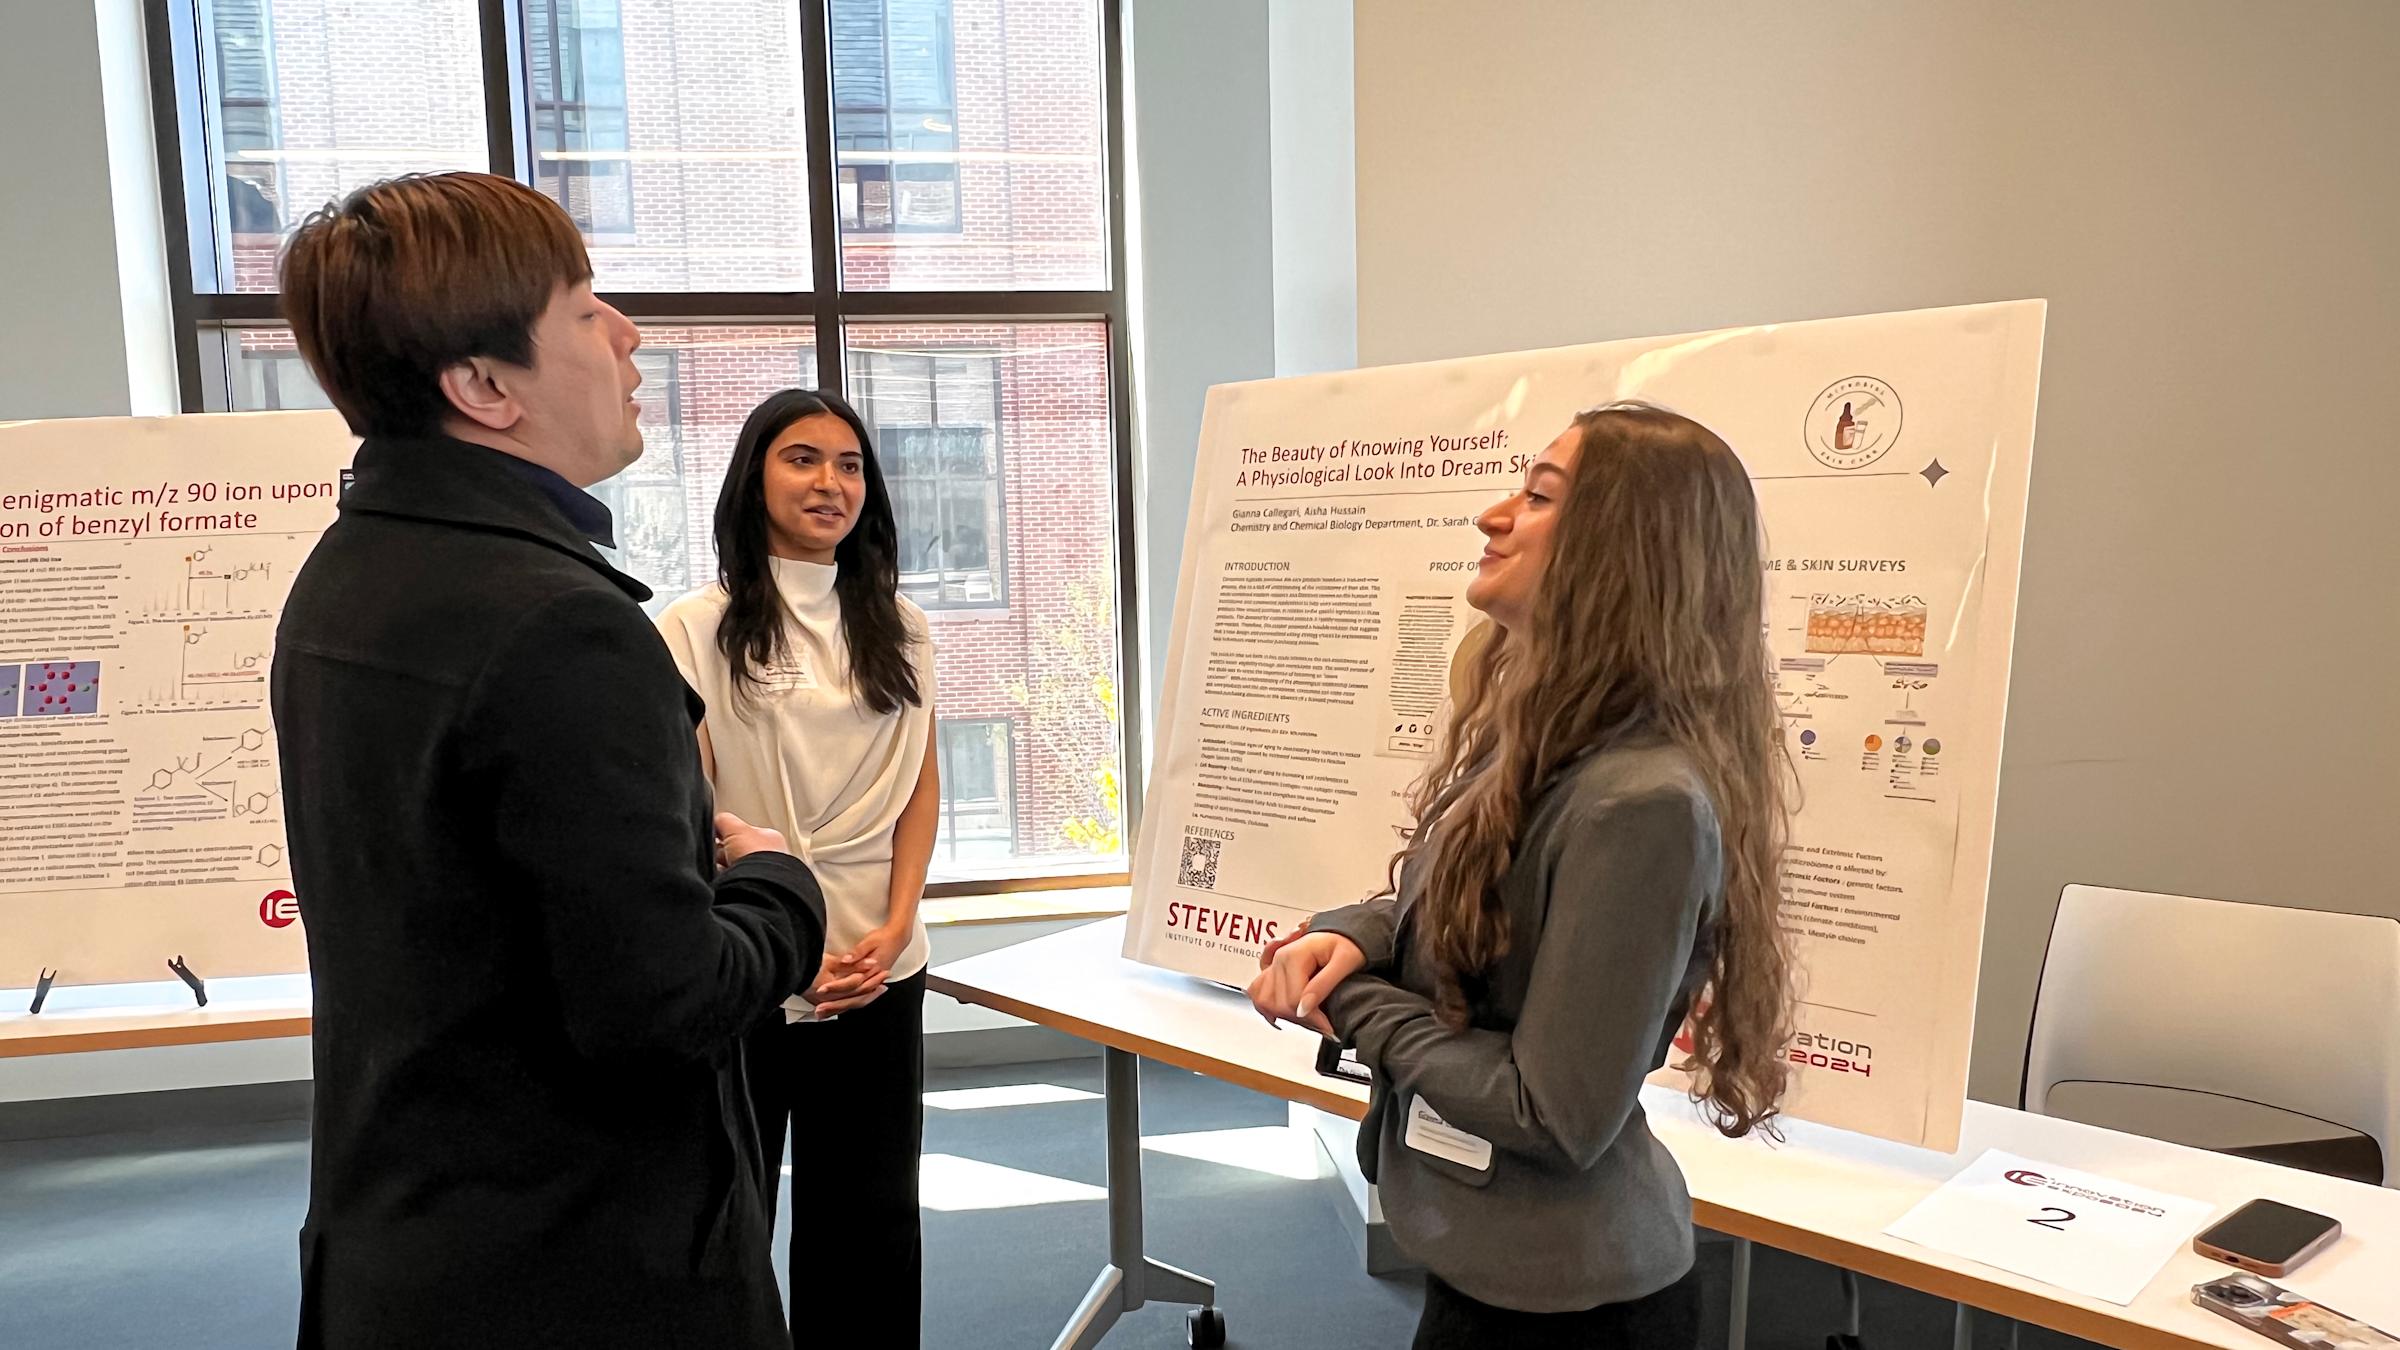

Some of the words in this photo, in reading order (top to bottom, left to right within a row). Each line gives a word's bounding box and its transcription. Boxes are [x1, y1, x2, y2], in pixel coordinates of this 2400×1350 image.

[1241, 448, 1267, 464] The
[1272, 445, 1325, 463] Beauty
[1329, 440, 1348, 458] of
[1351, 437, 1424, 458] Knowing
[1430, 430, 1509, 452] Yourself:
[1236, 471, 1247, 487] A
[1252, 463, 1350, 489] Physiological
[1355, 462, 1395, 481] Look
[1400, 462, 1436, 479] Into
[1441, 459, 1503, 477] Dream
[3, 489, 124, 513] enigmatic
[132, 481, 179, 508] m/z
[187, 482, 217, 503] 90
[226, 482, 262, 501] ion
[272, 482, 333, 503] upon
[1232, 509, 1261, 519] Gianna
[1304, 506, 1328, 516] Aisha
[1330, 506, 1366, 516] Hussain
[39, 515, 66, 537] of
[72, 512, 151, 538] benzyl
[160, 511, 257, 532] formate
[1231, 523, 1271, 533] Chemistry
[1273, 522, 1288, 531] and
[1289, 520, 1328, 531] Chemical
[1330, 520, 1362, 531] Biology
[1365, 519, 1423, 530] Department,
[1426, 517, 1439, 527] Dr.
[1442, 516, 1469, 527] Sarah
[1224, 562, 1291, 571] INTRODUCTION
[1429, 561, 1465, 571] PROOF
[1786, 559, 1797, 571] &
[1801, 559, 1834, 571] SKIN
[1838, 559, 1906, 571] SURVEYS
[1201, 707, 1229, 719] ACTIVE
[1232, 710, 1290, 723] INGREDIENTS
[1184, 824, 1235, 841] REFERENCES
[1167, 902, 1278, 946] STEVENS
[1165, 931, 1202, 947] INSTITUTE
[1205, 940, 1215, 949] OF
[2049, 1178, 2166, 1214] innovation
[2026, 1207, 2077, 1231] 2
